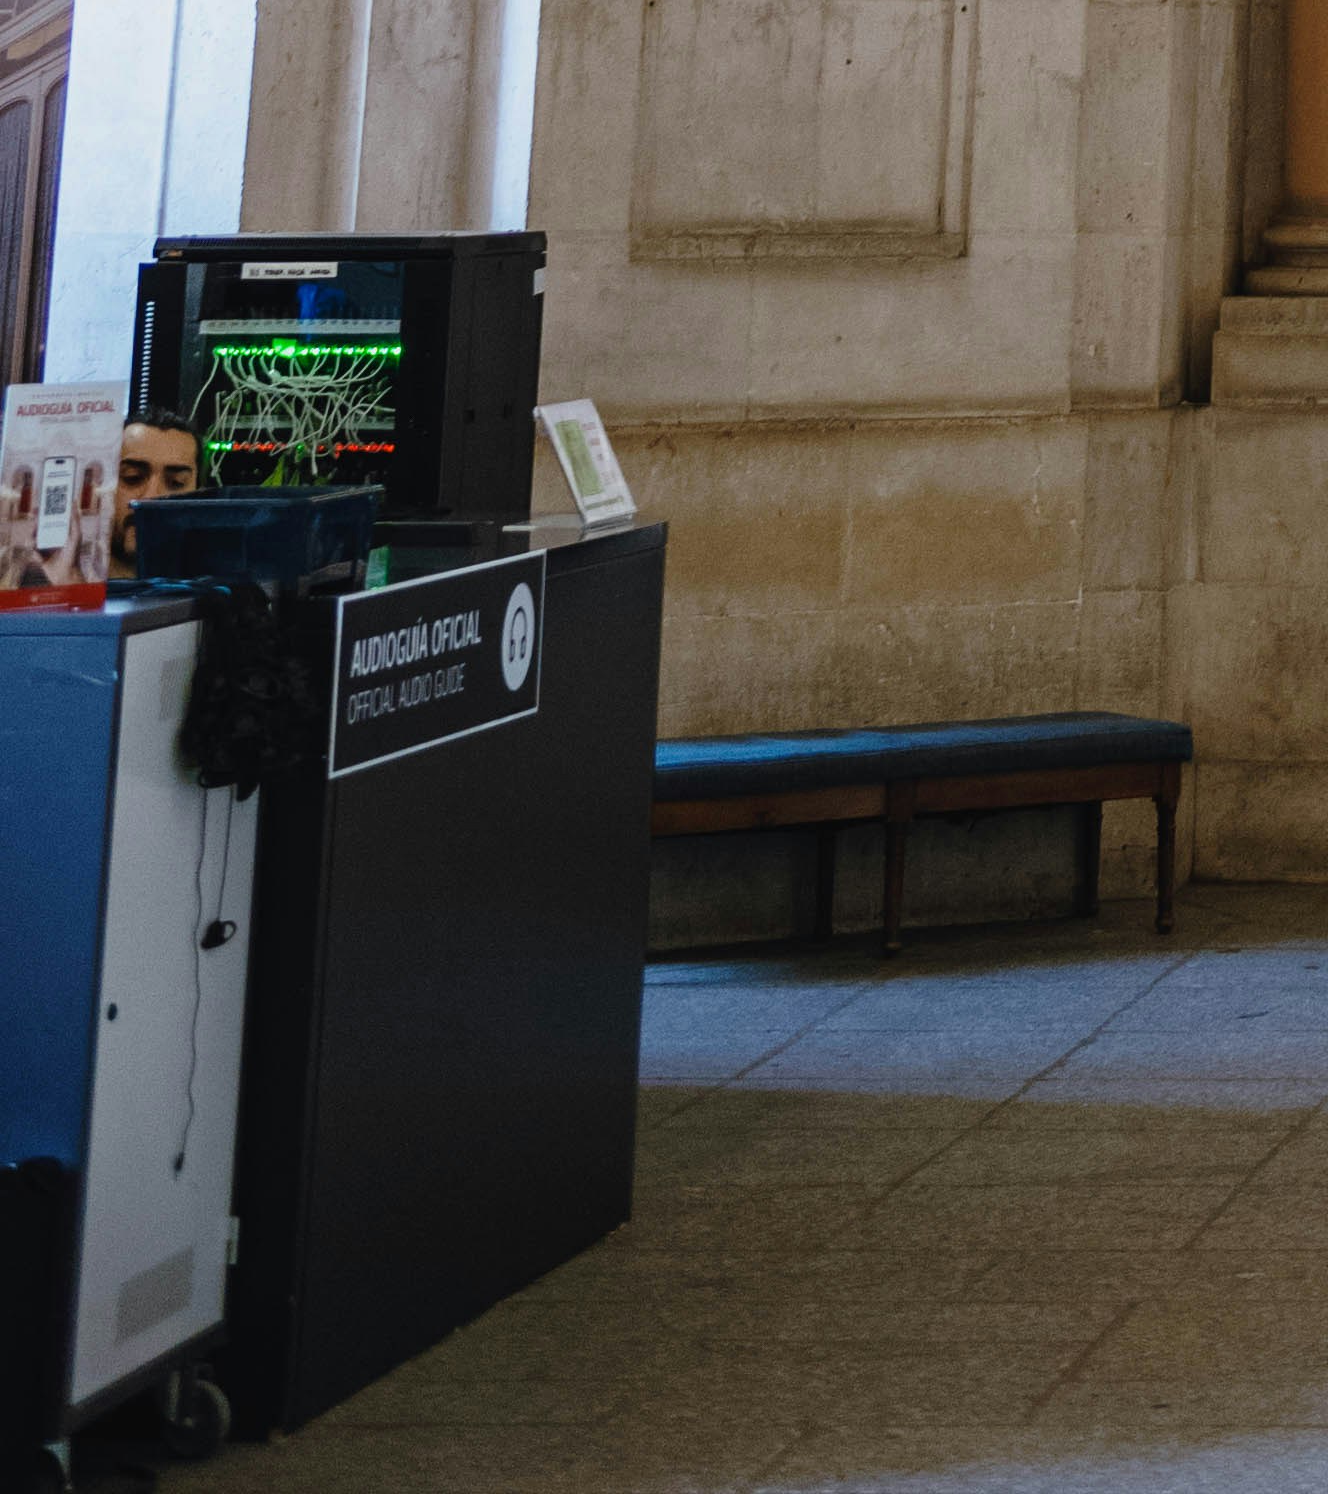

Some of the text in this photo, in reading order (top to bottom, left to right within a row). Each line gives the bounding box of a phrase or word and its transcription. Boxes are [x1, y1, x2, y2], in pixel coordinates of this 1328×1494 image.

[350, 609, 482, 678] AUDIOGUÍA OFICIAL
[347, 662, 466, 725] OFFICIAL AUDIO GUIDE
